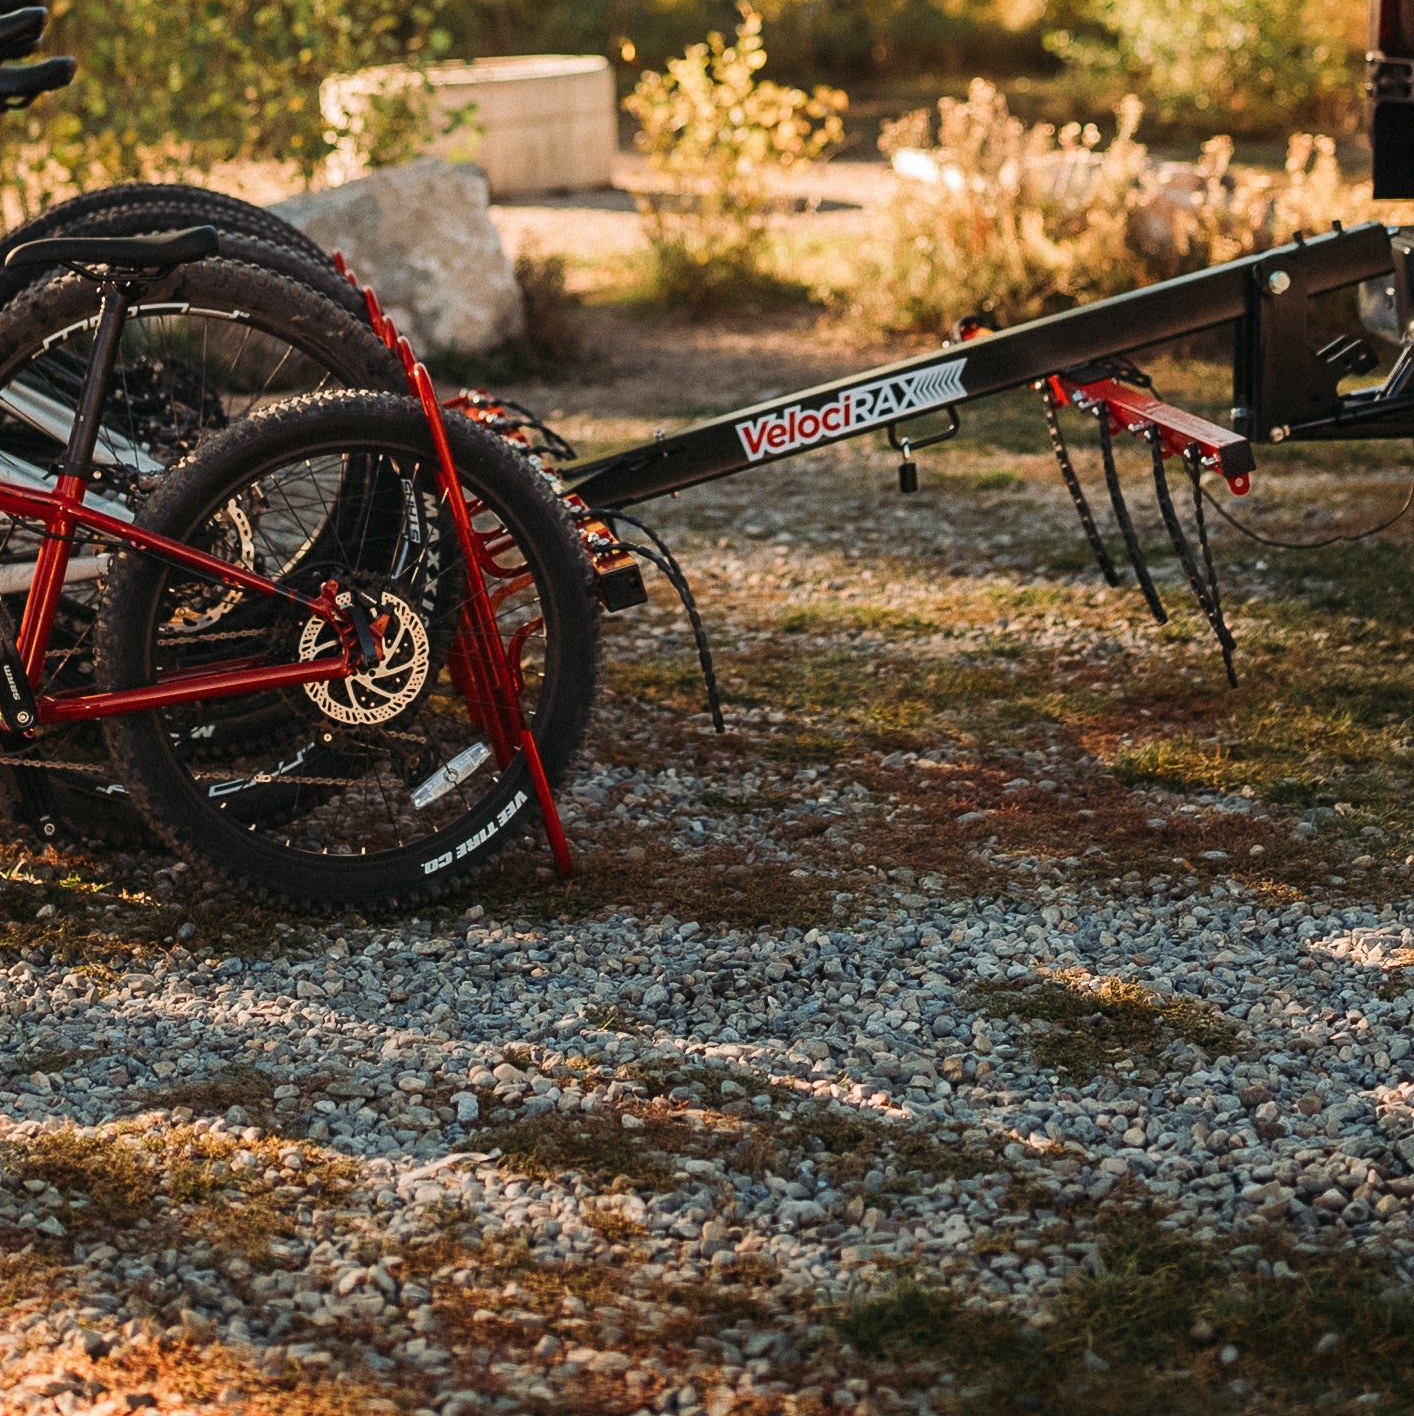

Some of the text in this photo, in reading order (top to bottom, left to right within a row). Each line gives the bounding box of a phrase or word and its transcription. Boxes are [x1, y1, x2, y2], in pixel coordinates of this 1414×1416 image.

[742, 375, 918, 455] VelociRAX
[421, 491, 441, 628] MAXXIS
[3, 664, 21, 701] SRAM
[420, 790, 528, 875] VEE TIRE CO.
